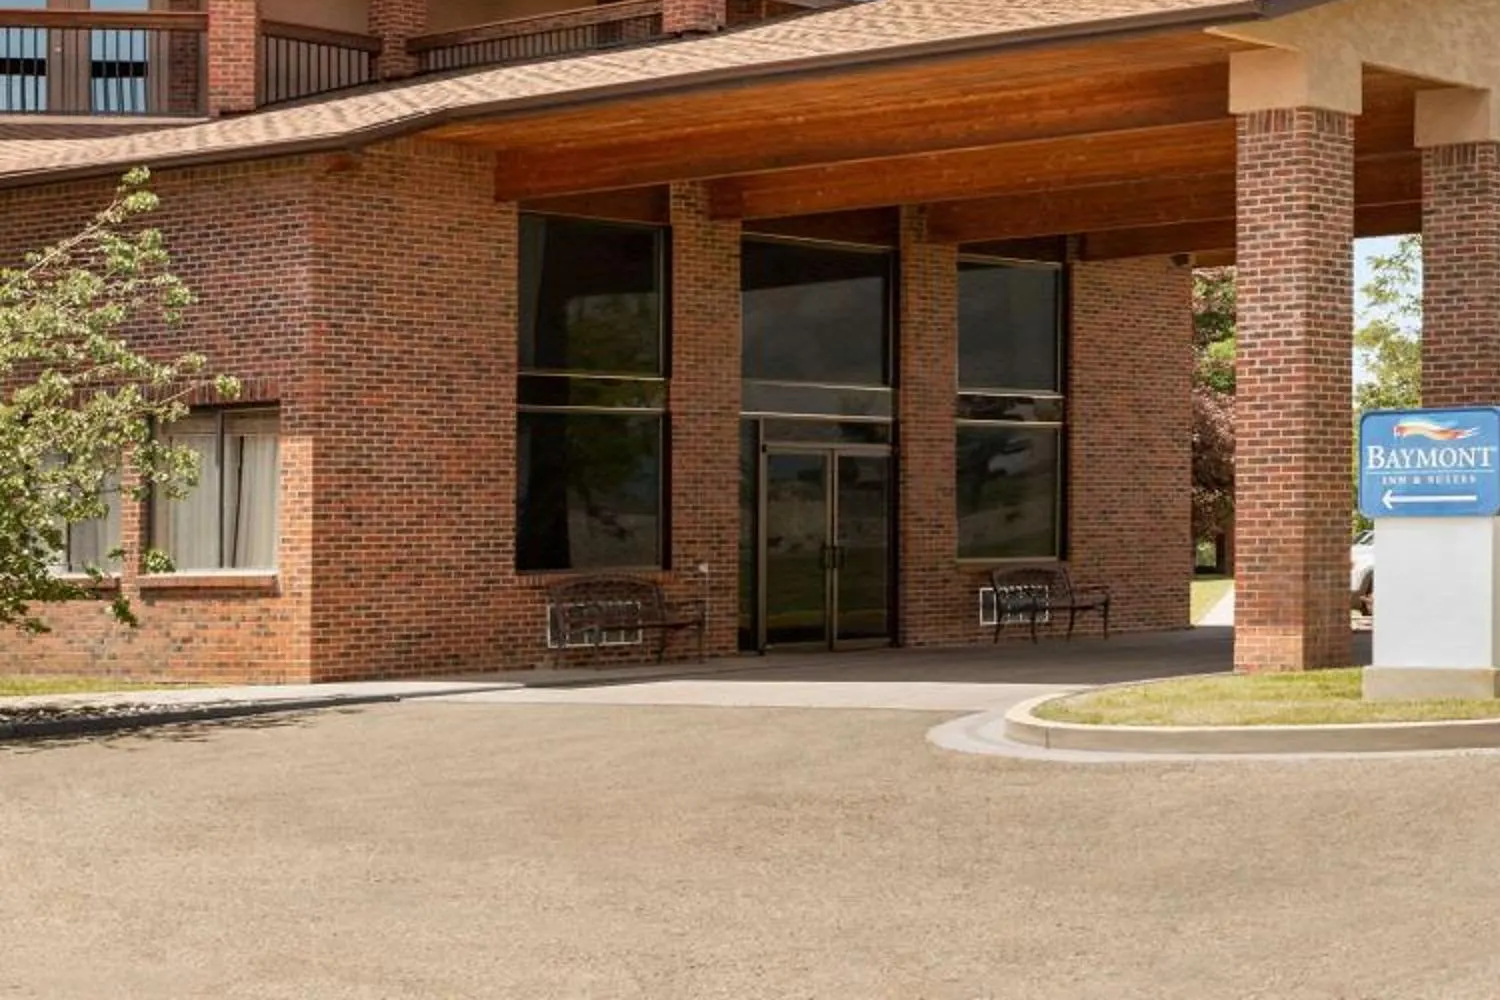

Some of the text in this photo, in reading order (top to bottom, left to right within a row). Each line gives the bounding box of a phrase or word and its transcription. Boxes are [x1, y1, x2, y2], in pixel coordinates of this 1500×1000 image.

[1366, 444, 1494, 469] BAYMONT
[1381, 474, 1408, 485] INN
[1412, 475, 1422, 485] &
